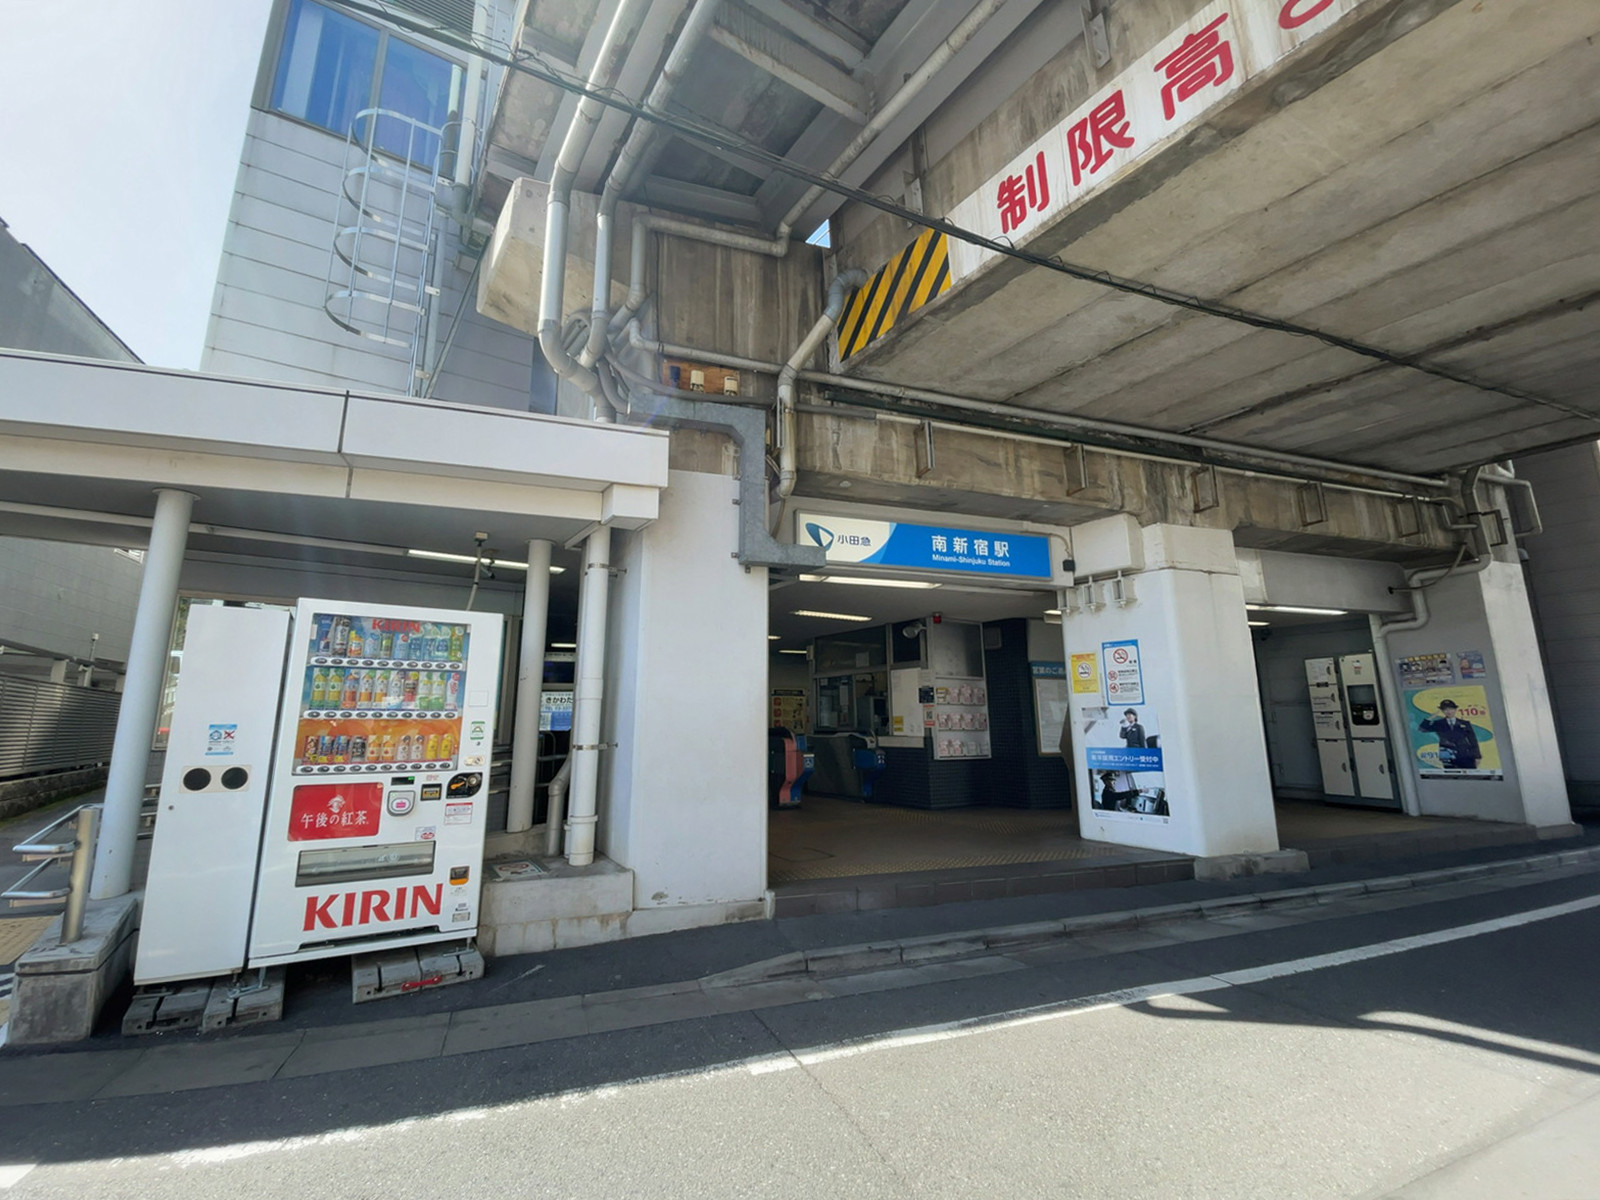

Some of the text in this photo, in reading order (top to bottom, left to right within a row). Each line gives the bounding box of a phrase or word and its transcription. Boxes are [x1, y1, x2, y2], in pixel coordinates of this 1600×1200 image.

[837, 534, 872, 548] 小田急
[931, 535, 1010, 558] 南新宿駅
[932, 553, 1011, 567] Minami-Shinjuku Station
[371, 618, 421, 633] KIRIN
[301, 810, 368, 829] 午後の紅茶
[303, 883, 444, 932] KIRIN
